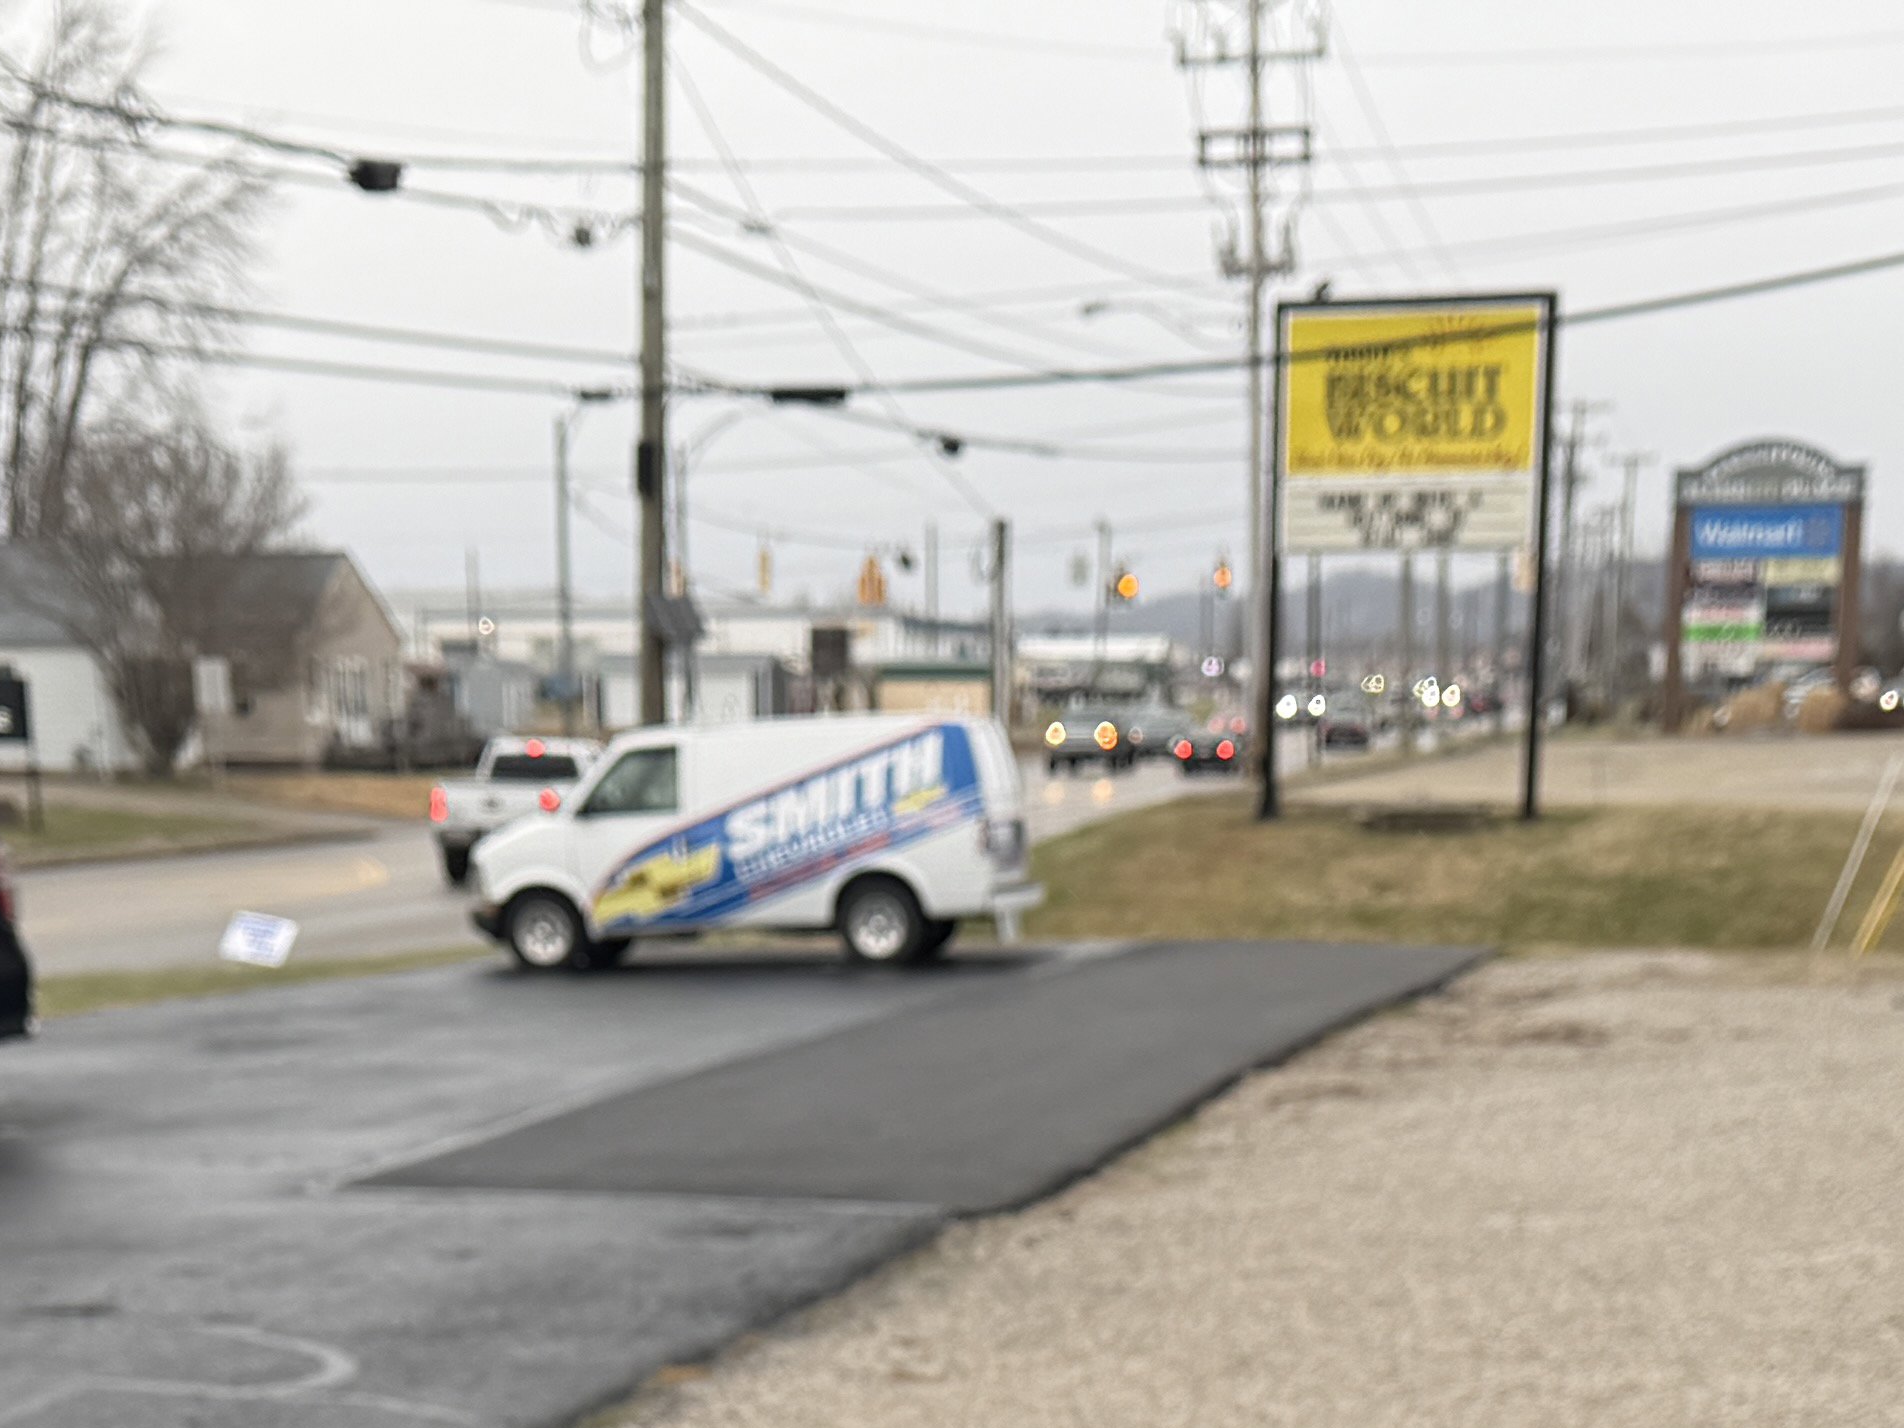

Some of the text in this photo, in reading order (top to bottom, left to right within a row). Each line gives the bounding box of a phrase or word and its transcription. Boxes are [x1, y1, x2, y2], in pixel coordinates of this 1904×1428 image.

[1325, 364, 1504, 408] BISCUIT
[1326, 402, 1508, 444] WORLD
[1697, 519, 1804, 549] Walmart
[725, 732, 945, 862] SMITH
